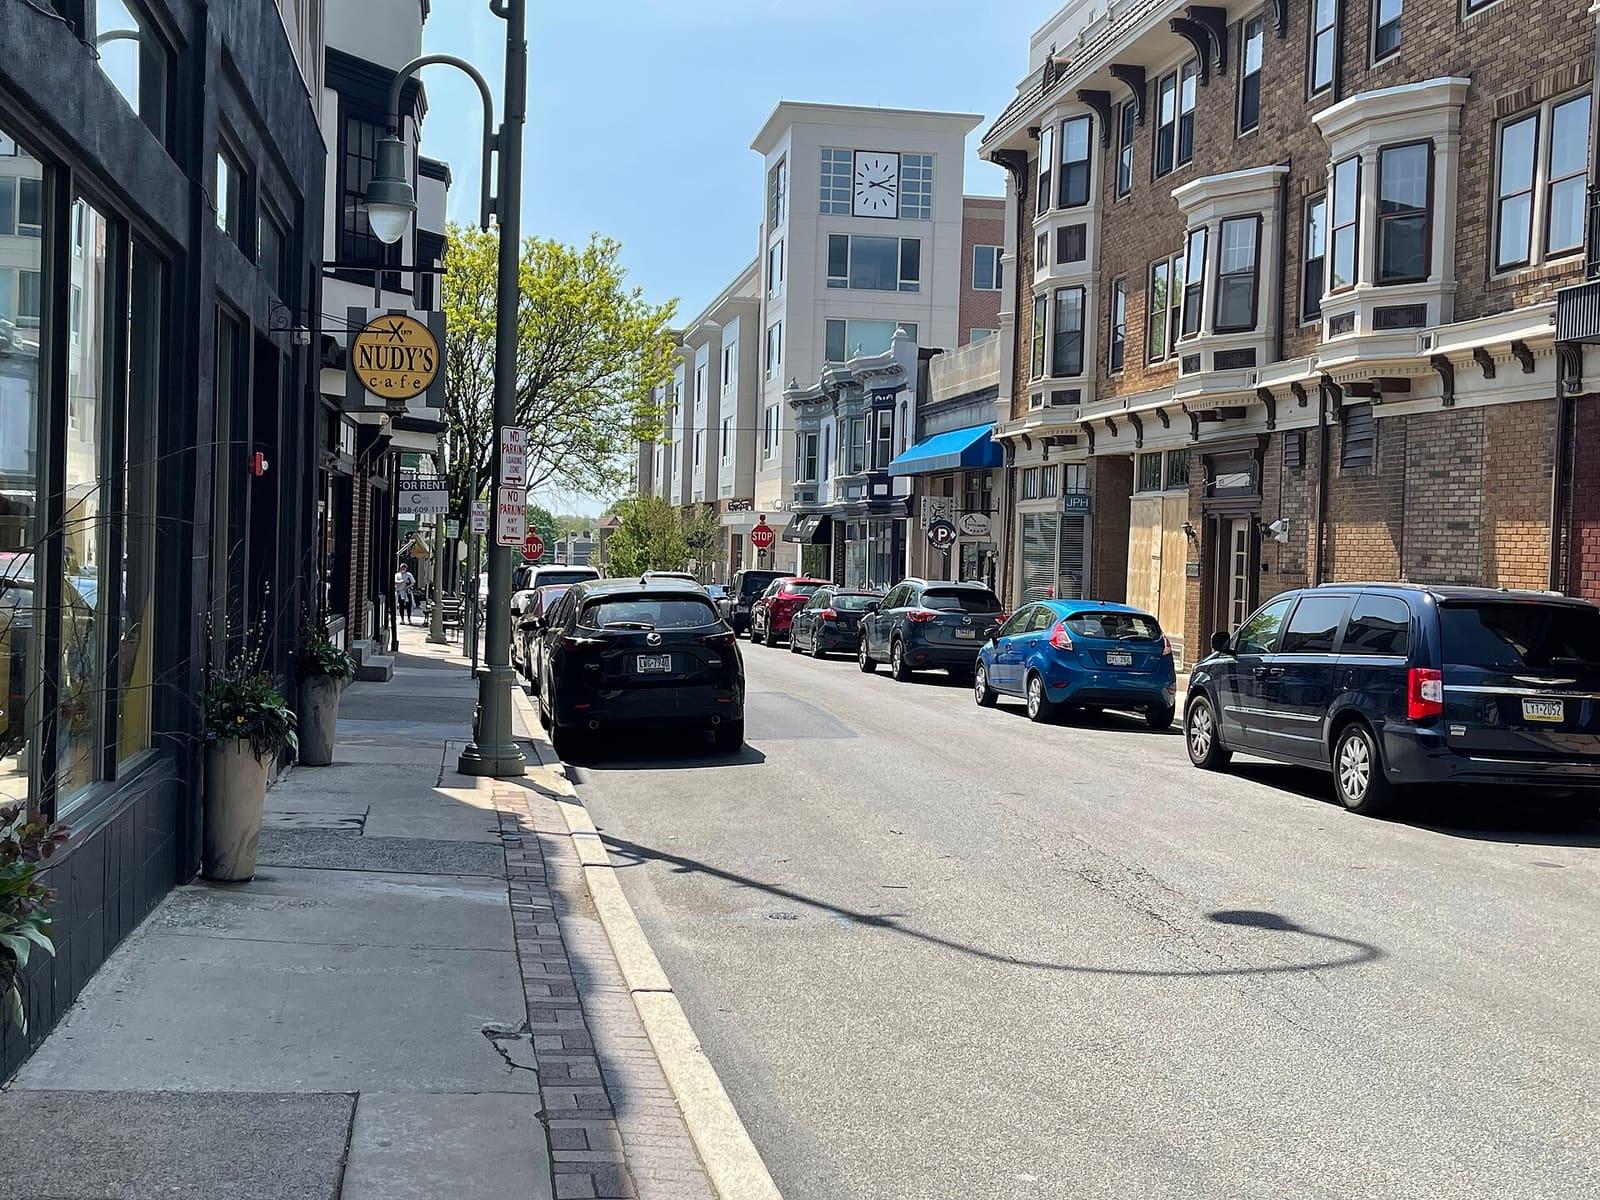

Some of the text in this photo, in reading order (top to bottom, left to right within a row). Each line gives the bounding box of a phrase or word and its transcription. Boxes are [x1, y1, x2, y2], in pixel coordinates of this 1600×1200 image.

[359, 344, 434, 372] NUDY'S
[510, 430, 520, 442] NO
[502, 442, 528, 456] PARKING
[420, 480, 447, 490] RENT
[507, 490, 519, 502] NO
[1066, 497, 1089, 508] JPH
[500, 503, 526, 516] PARKING
[507, 526, 518, 534] TIME
[937, 528, 948, 542] P
[752, 531, 773, 542] STOP
[522, 543, 543, 553] STOP
